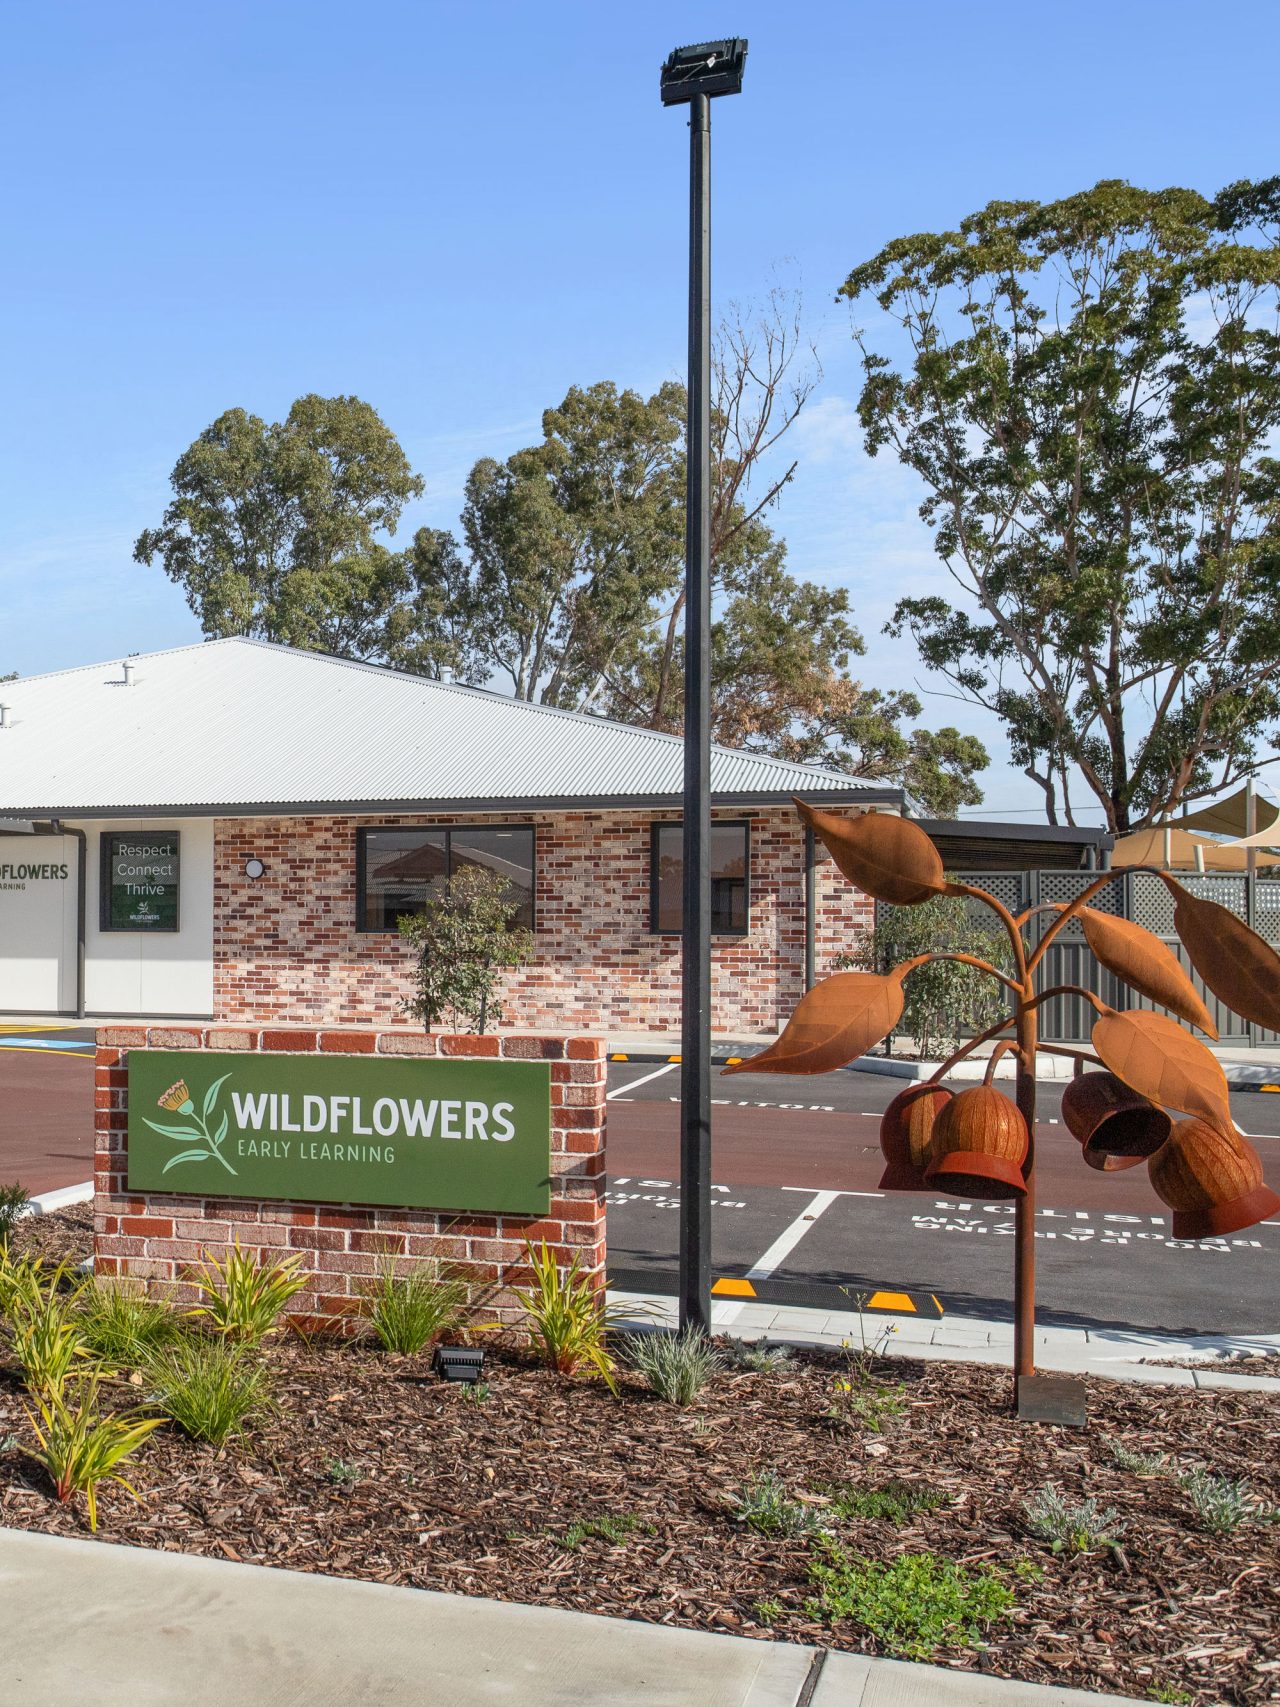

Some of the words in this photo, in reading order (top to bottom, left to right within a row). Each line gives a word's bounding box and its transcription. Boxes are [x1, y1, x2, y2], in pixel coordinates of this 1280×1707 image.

[119, 844, 172, 859] Respect
[117, 863, 173, 876] Connect
[124, 883, 165, 895] Thrive
[231, 1091, 516, 1143] WILDFLOWERS
[237, 1139, 292, 1158] EARLY
[299, 1141, 395, 1164] LEARNING
[934, 1201, 1166, 1225] ISITOR
[1165, 1241, 1232, 1253] NO
